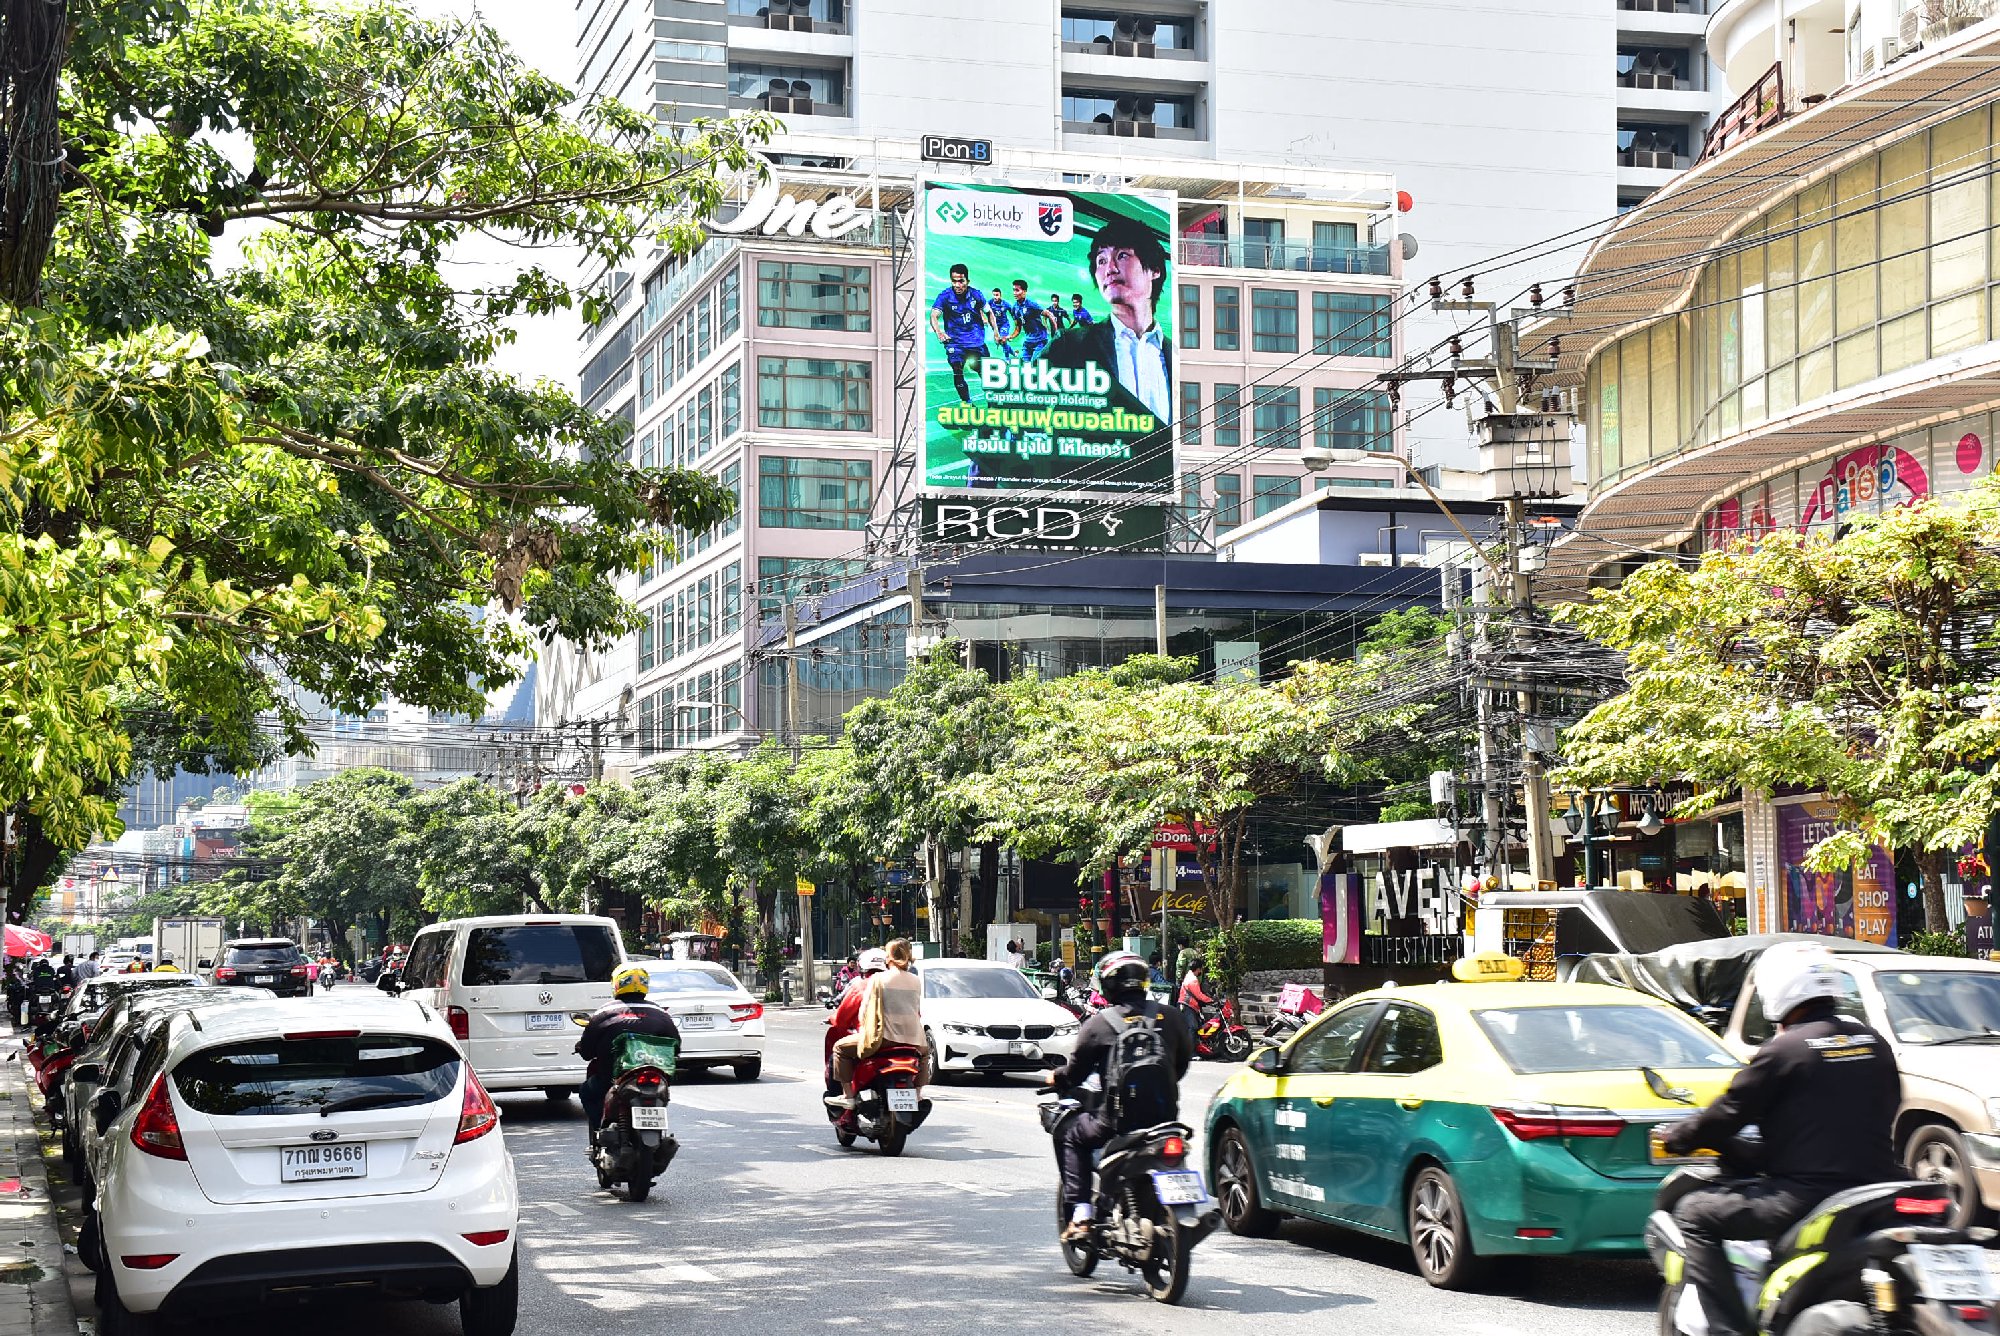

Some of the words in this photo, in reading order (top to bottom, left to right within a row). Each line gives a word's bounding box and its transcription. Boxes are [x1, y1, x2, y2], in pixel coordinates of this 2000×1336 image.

[973, 202, 1022, 222] bitkub
[980, 357, 1111, 394] Bitkub
[985, 391, 1024, 405] Capital
[1025, 392, 1058, 406] Group
[1059, 394, 1108, 408] Holdings
[937, 401, 1155, 436] สนับสนุนฟุตบอลไทย
[962, 429, 1010, 453] เชื่อมั่น
[936, 504, 1081, 541] RCD
[1857, 863, 1878, 880] EAT
[1857, 890, 1890, 909] SHOP
[1858, 918, 1888, 936] PLAY
[1371, 936, 1448, 965] LIFESTYLE
[322, 1146, 363, 1163] 9666
[294, 1166, 354, 1178] กรุงเทพมหานคร
